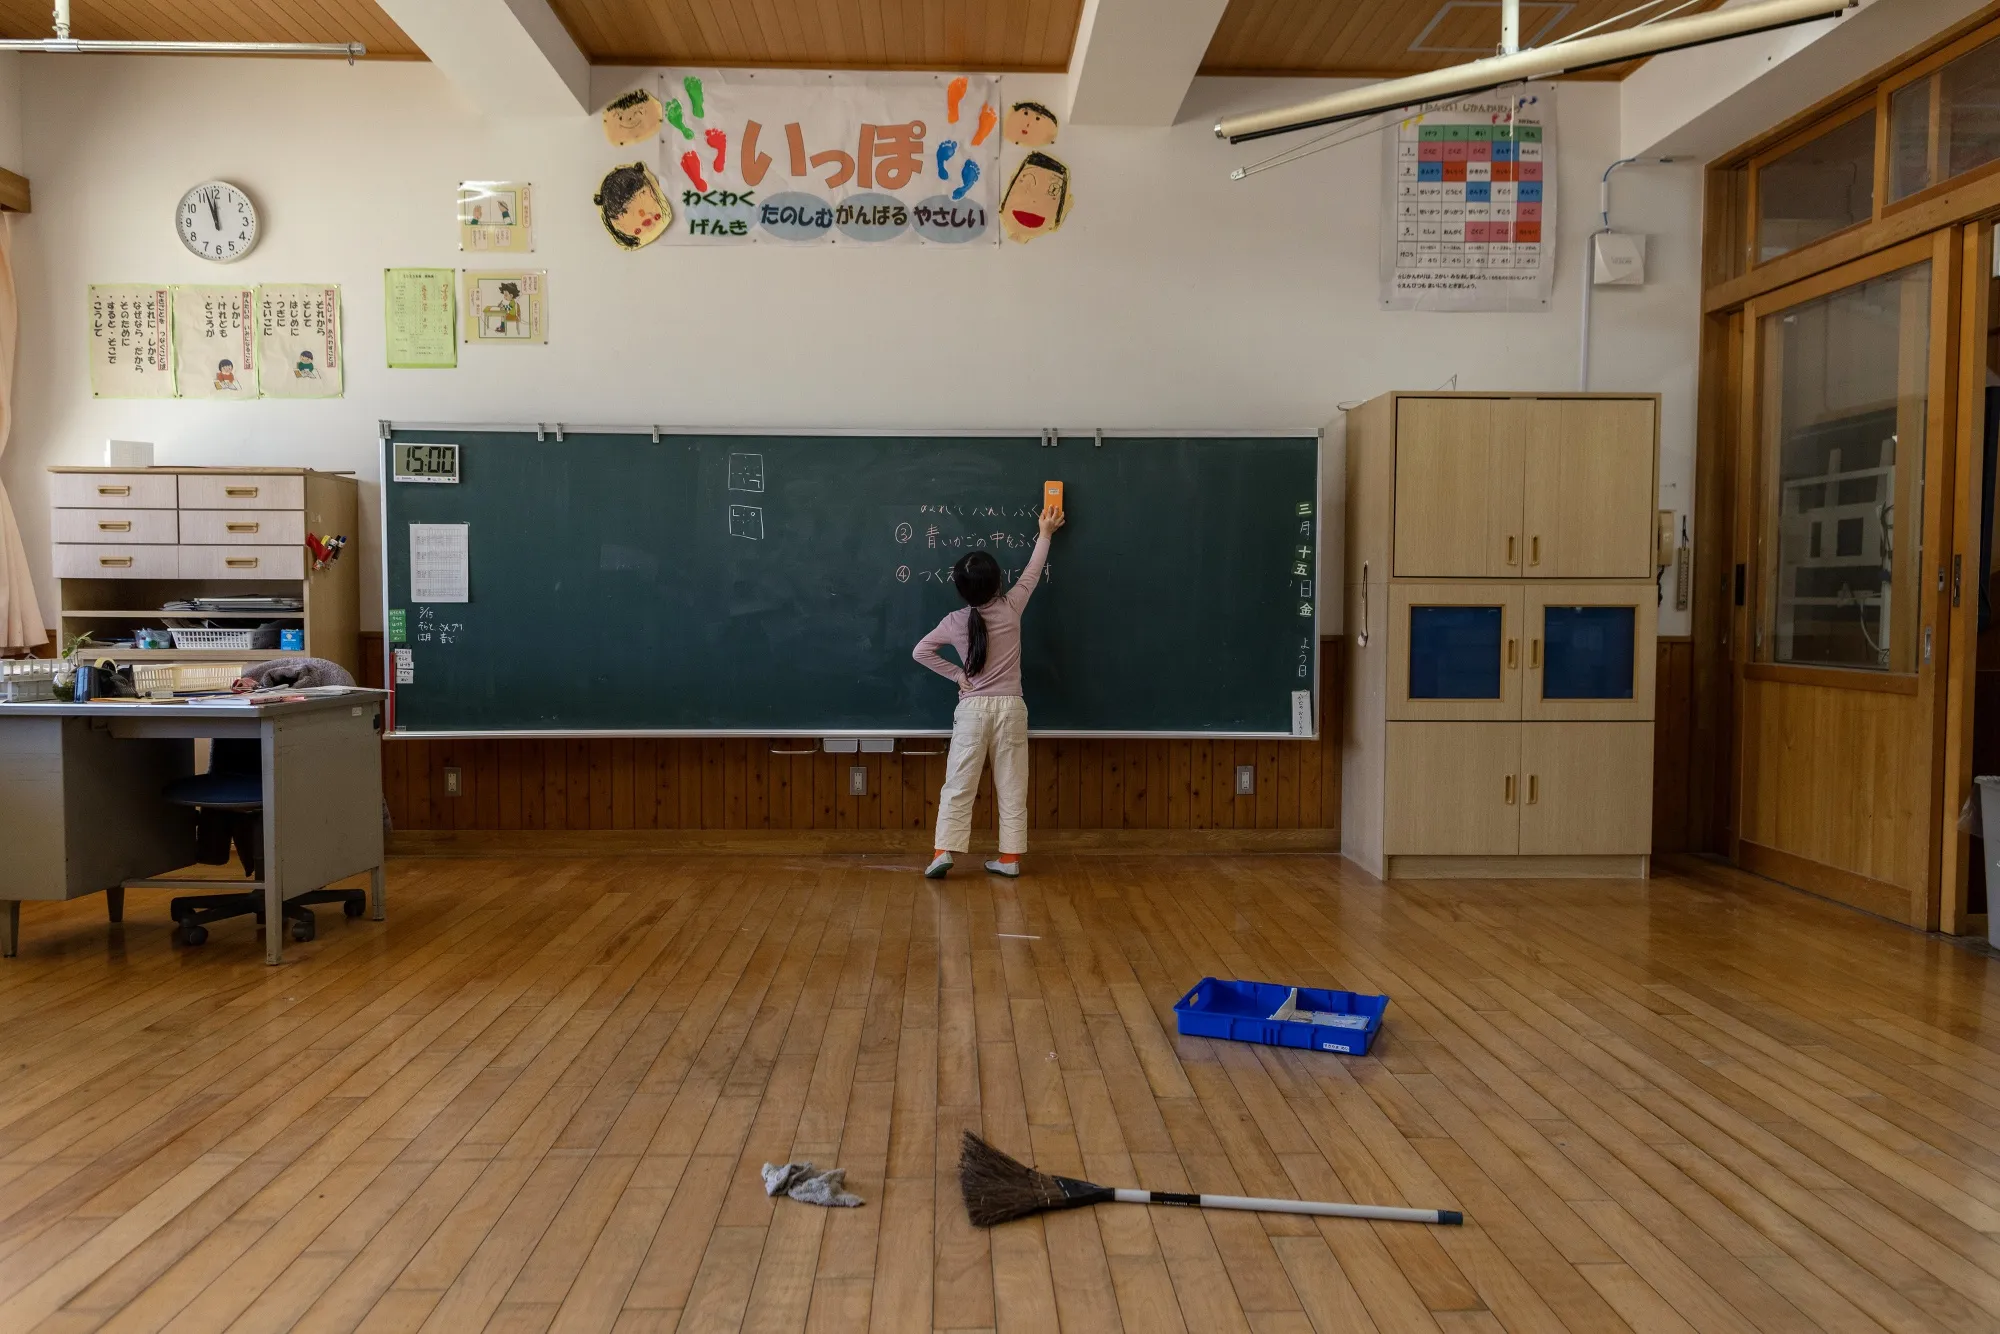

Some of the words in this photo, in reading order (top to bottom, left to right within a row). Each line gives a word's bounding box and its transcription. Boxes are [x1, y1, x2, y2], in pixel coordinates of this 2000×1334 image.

[741, 119, 926, 190] いっぽ
[199, 193, 205, 204] 11
[211, 189, 221, 200] 12
[682, 189, 755, 207] わくわく
[188, 204, 197, 214] 10
[238, 203, 244, 213] 2
[761, 204, 833, 229] たのしむ
[836, 204, 907, 226] がんばる
[913, 206, 985, 228] やさしい
[186, 218, 192, 228] 9
[242, 217, 249, 227] 3
[690, 218, 748, 236] げんき
[190, 232, 197, 242] 8
[239, 231, 246, 241] 4
[203, 242, 209, 252] 7
[216, 245, 222, 255] 6
[228, 241, 235, 251] 5
[94, 301, 103, 337] こうして
[205, 301, 215, 338] ところが
[231, 301, 240, 329] しかし
[263, 300, 272, 336] さいごに
[276, 300, 286, 327] つぎに
[289, 300, 299, 337] はじめに
[303, 300, 312, 328] そして
[316, 300, 326, 336] それから
[120, 301, 130, 347] そのために
[406, 446, 455, 474] 15:00
[419, 606, 434, 619] 3/15
